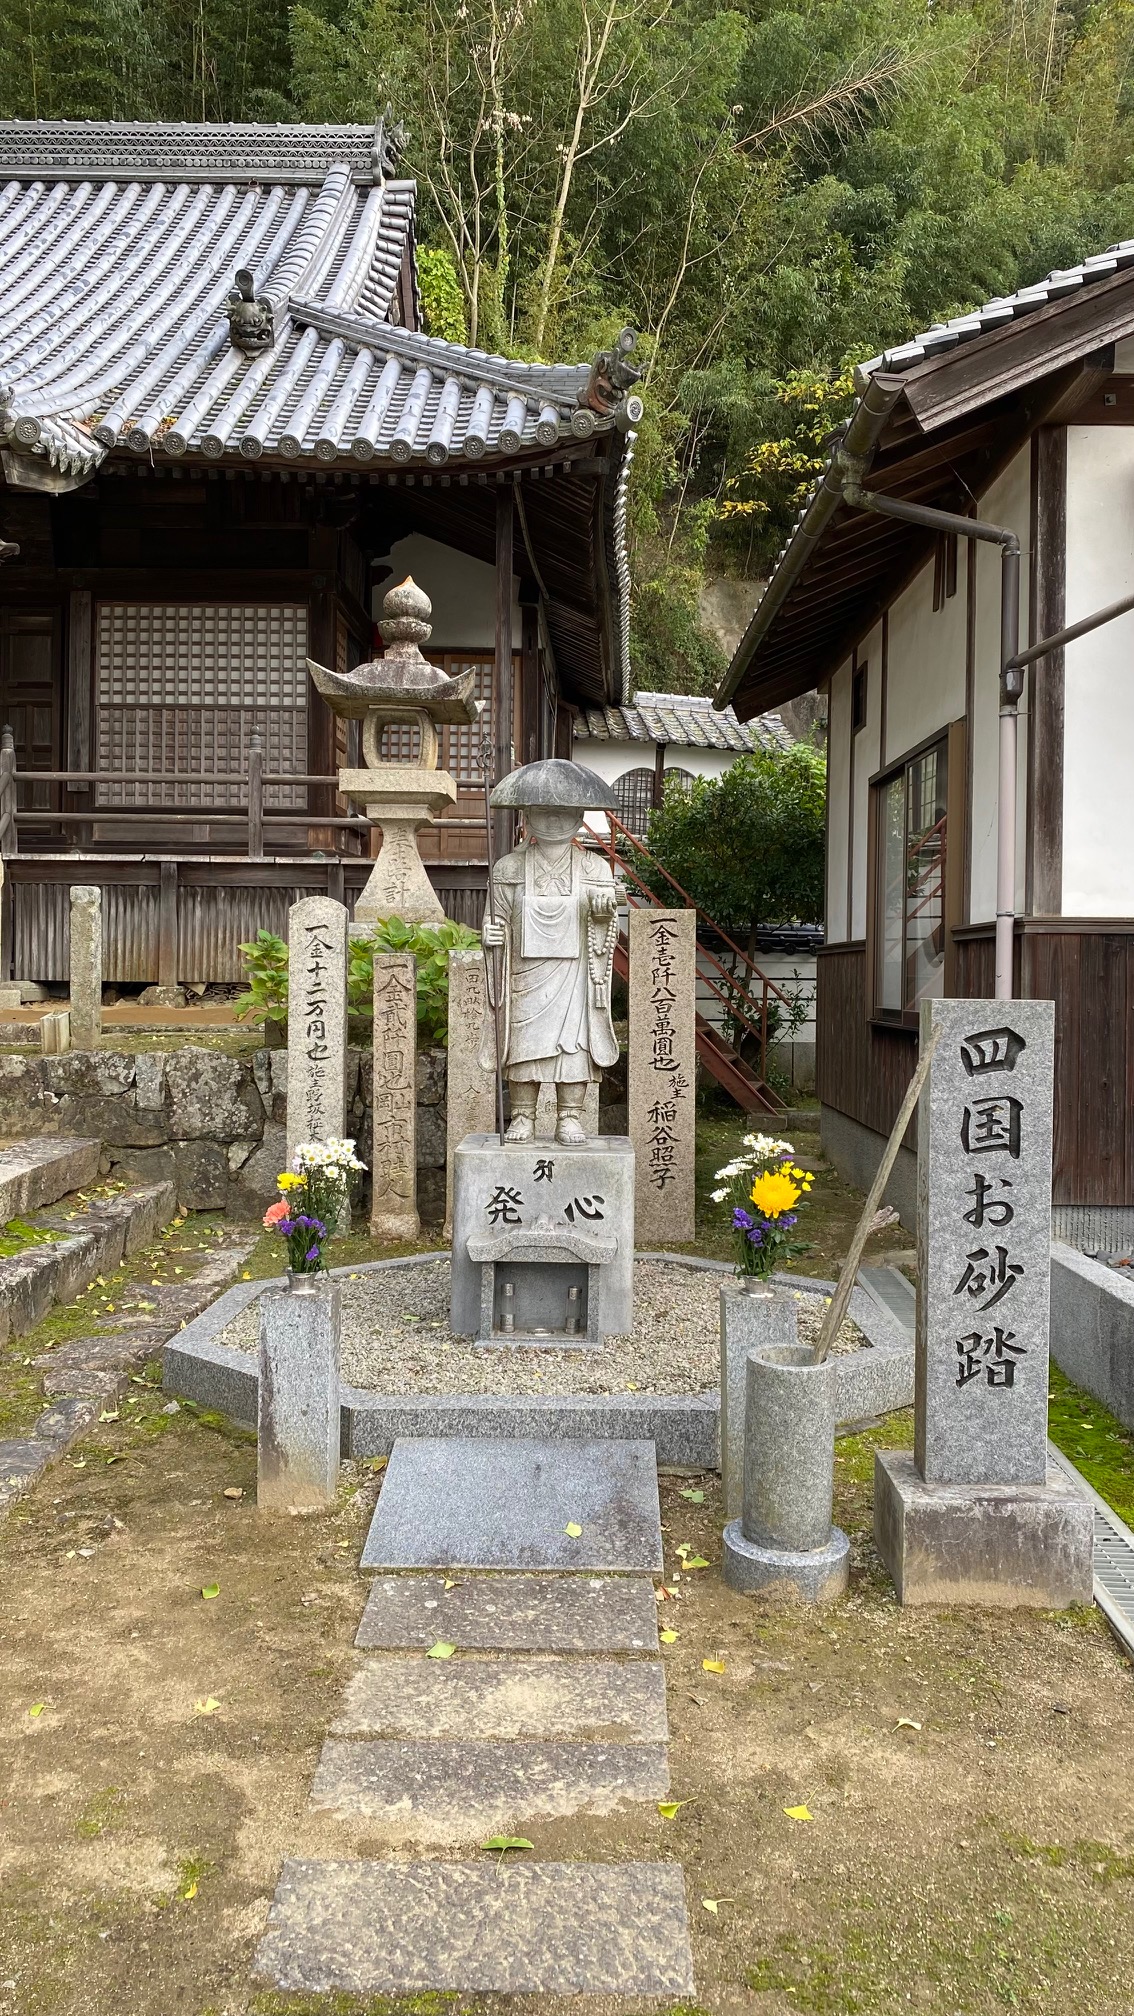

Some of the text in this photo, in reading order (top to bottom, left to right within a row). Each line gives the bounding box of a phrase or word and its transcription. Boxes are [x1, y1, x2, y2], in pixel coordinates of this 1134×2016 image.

[668, 1073, 689, 1099] 施主
[953, 1026, 1027, 1389] 四国お砂踏
